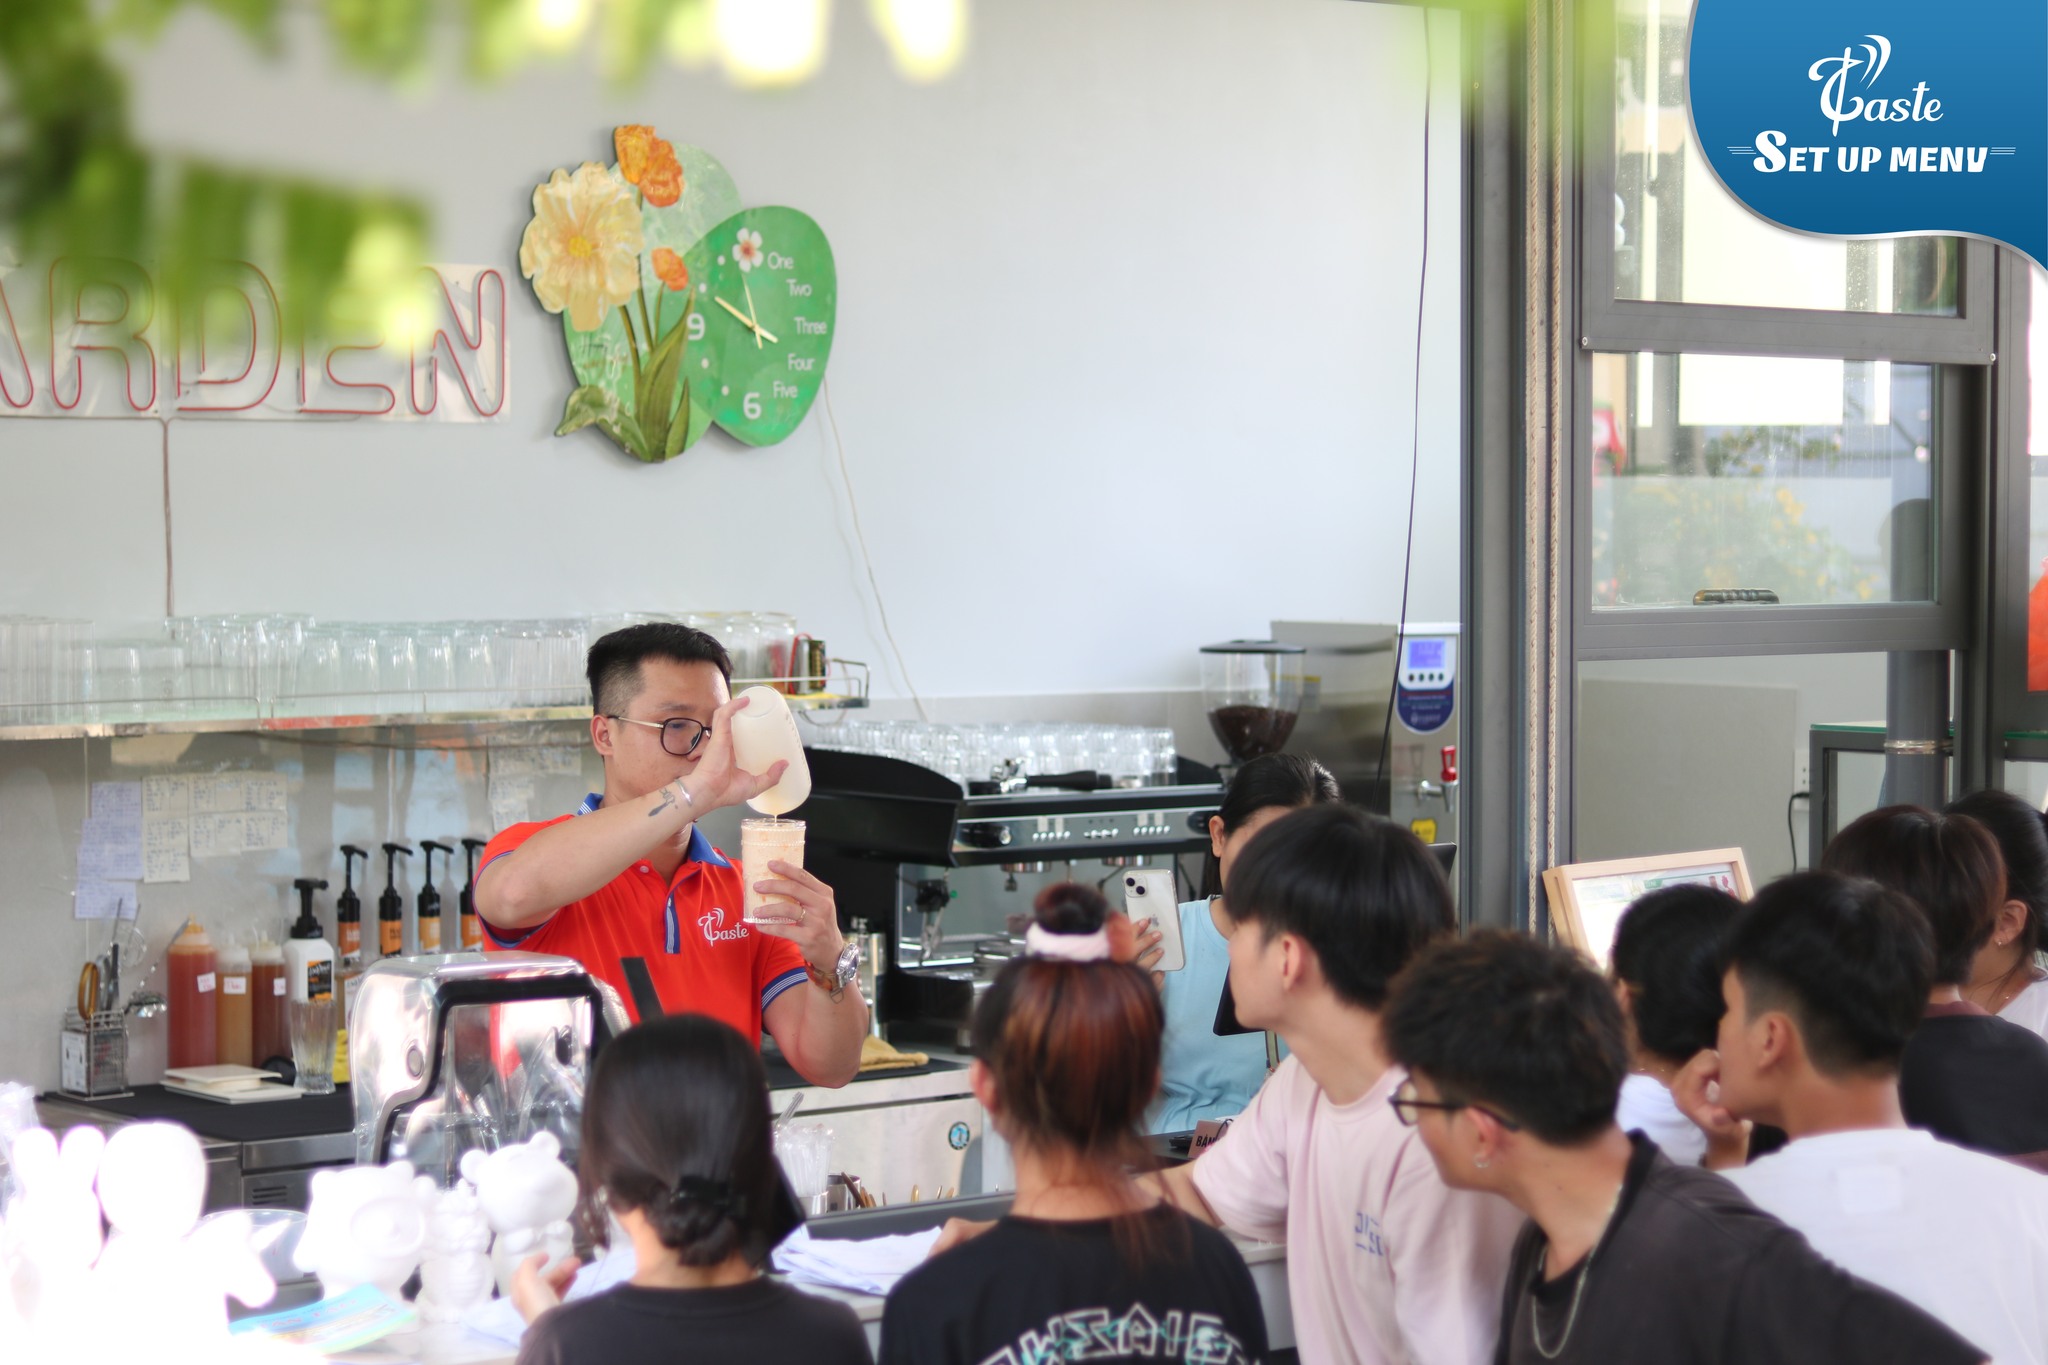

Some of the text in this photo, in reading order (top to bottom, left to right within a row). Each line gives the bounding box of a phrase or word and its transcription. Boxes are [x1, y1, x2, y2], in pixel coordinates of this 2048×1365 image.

[767, 252, 794, 270] One
[786, 278, 812, 297] Two
[686, 313, 705, 340] 9
[793, 317, 827, 335] Three
[788, 353, 815, 371] Four
[773, 380, 798, 398] Five
[743, 392, 761, 419] 6
[697, 907, 749, 947] Taste
